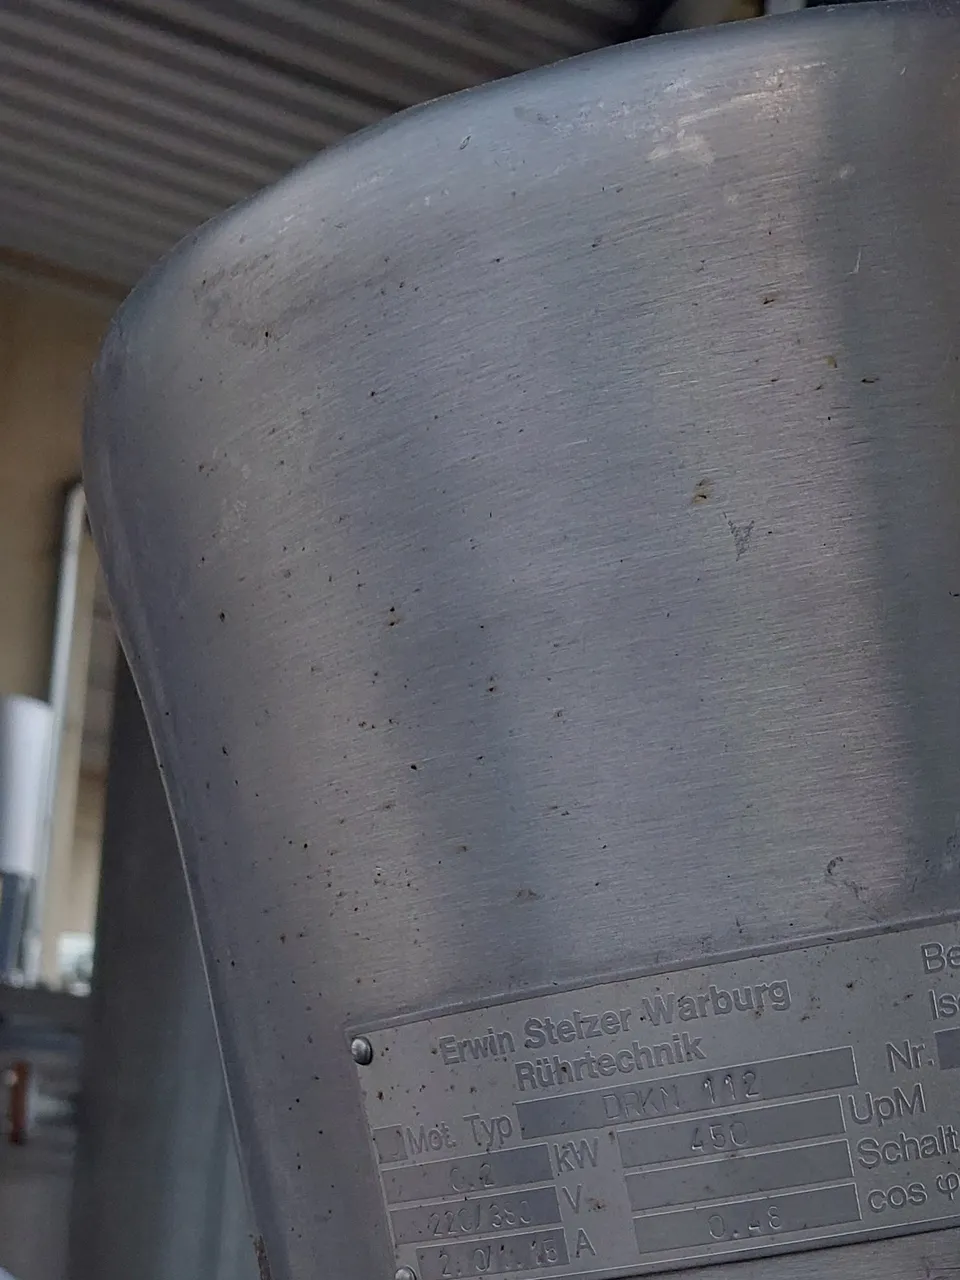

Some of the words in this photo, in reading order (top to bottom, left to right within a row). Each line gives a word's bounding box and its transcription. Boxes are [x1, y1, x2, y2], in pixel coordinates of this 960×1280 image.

[438, 1027, 516, 1066] Erwin
[523, 1008, 632, 1049] Stelzer
[642, 978, 792, 1027] Warburg
[514, 1032, 706, 1091] Rührtechnik
[886, 1037, 936, 1074] Nr.
[405, 1121, 457, 1156] Mot.
[463, 1113, 514, 1150] Typ
[702, 1070, 761, 1104] 112
[691, 1121, 750, 1153] 450
[848, 1081, 927, 1131] UpM
[552, 1137, 599, 1174] kW
[561, 1183, 583, 1215] V
[867, 1180, 928, 1214] cos
[575, 1228, 598, 1259] A
